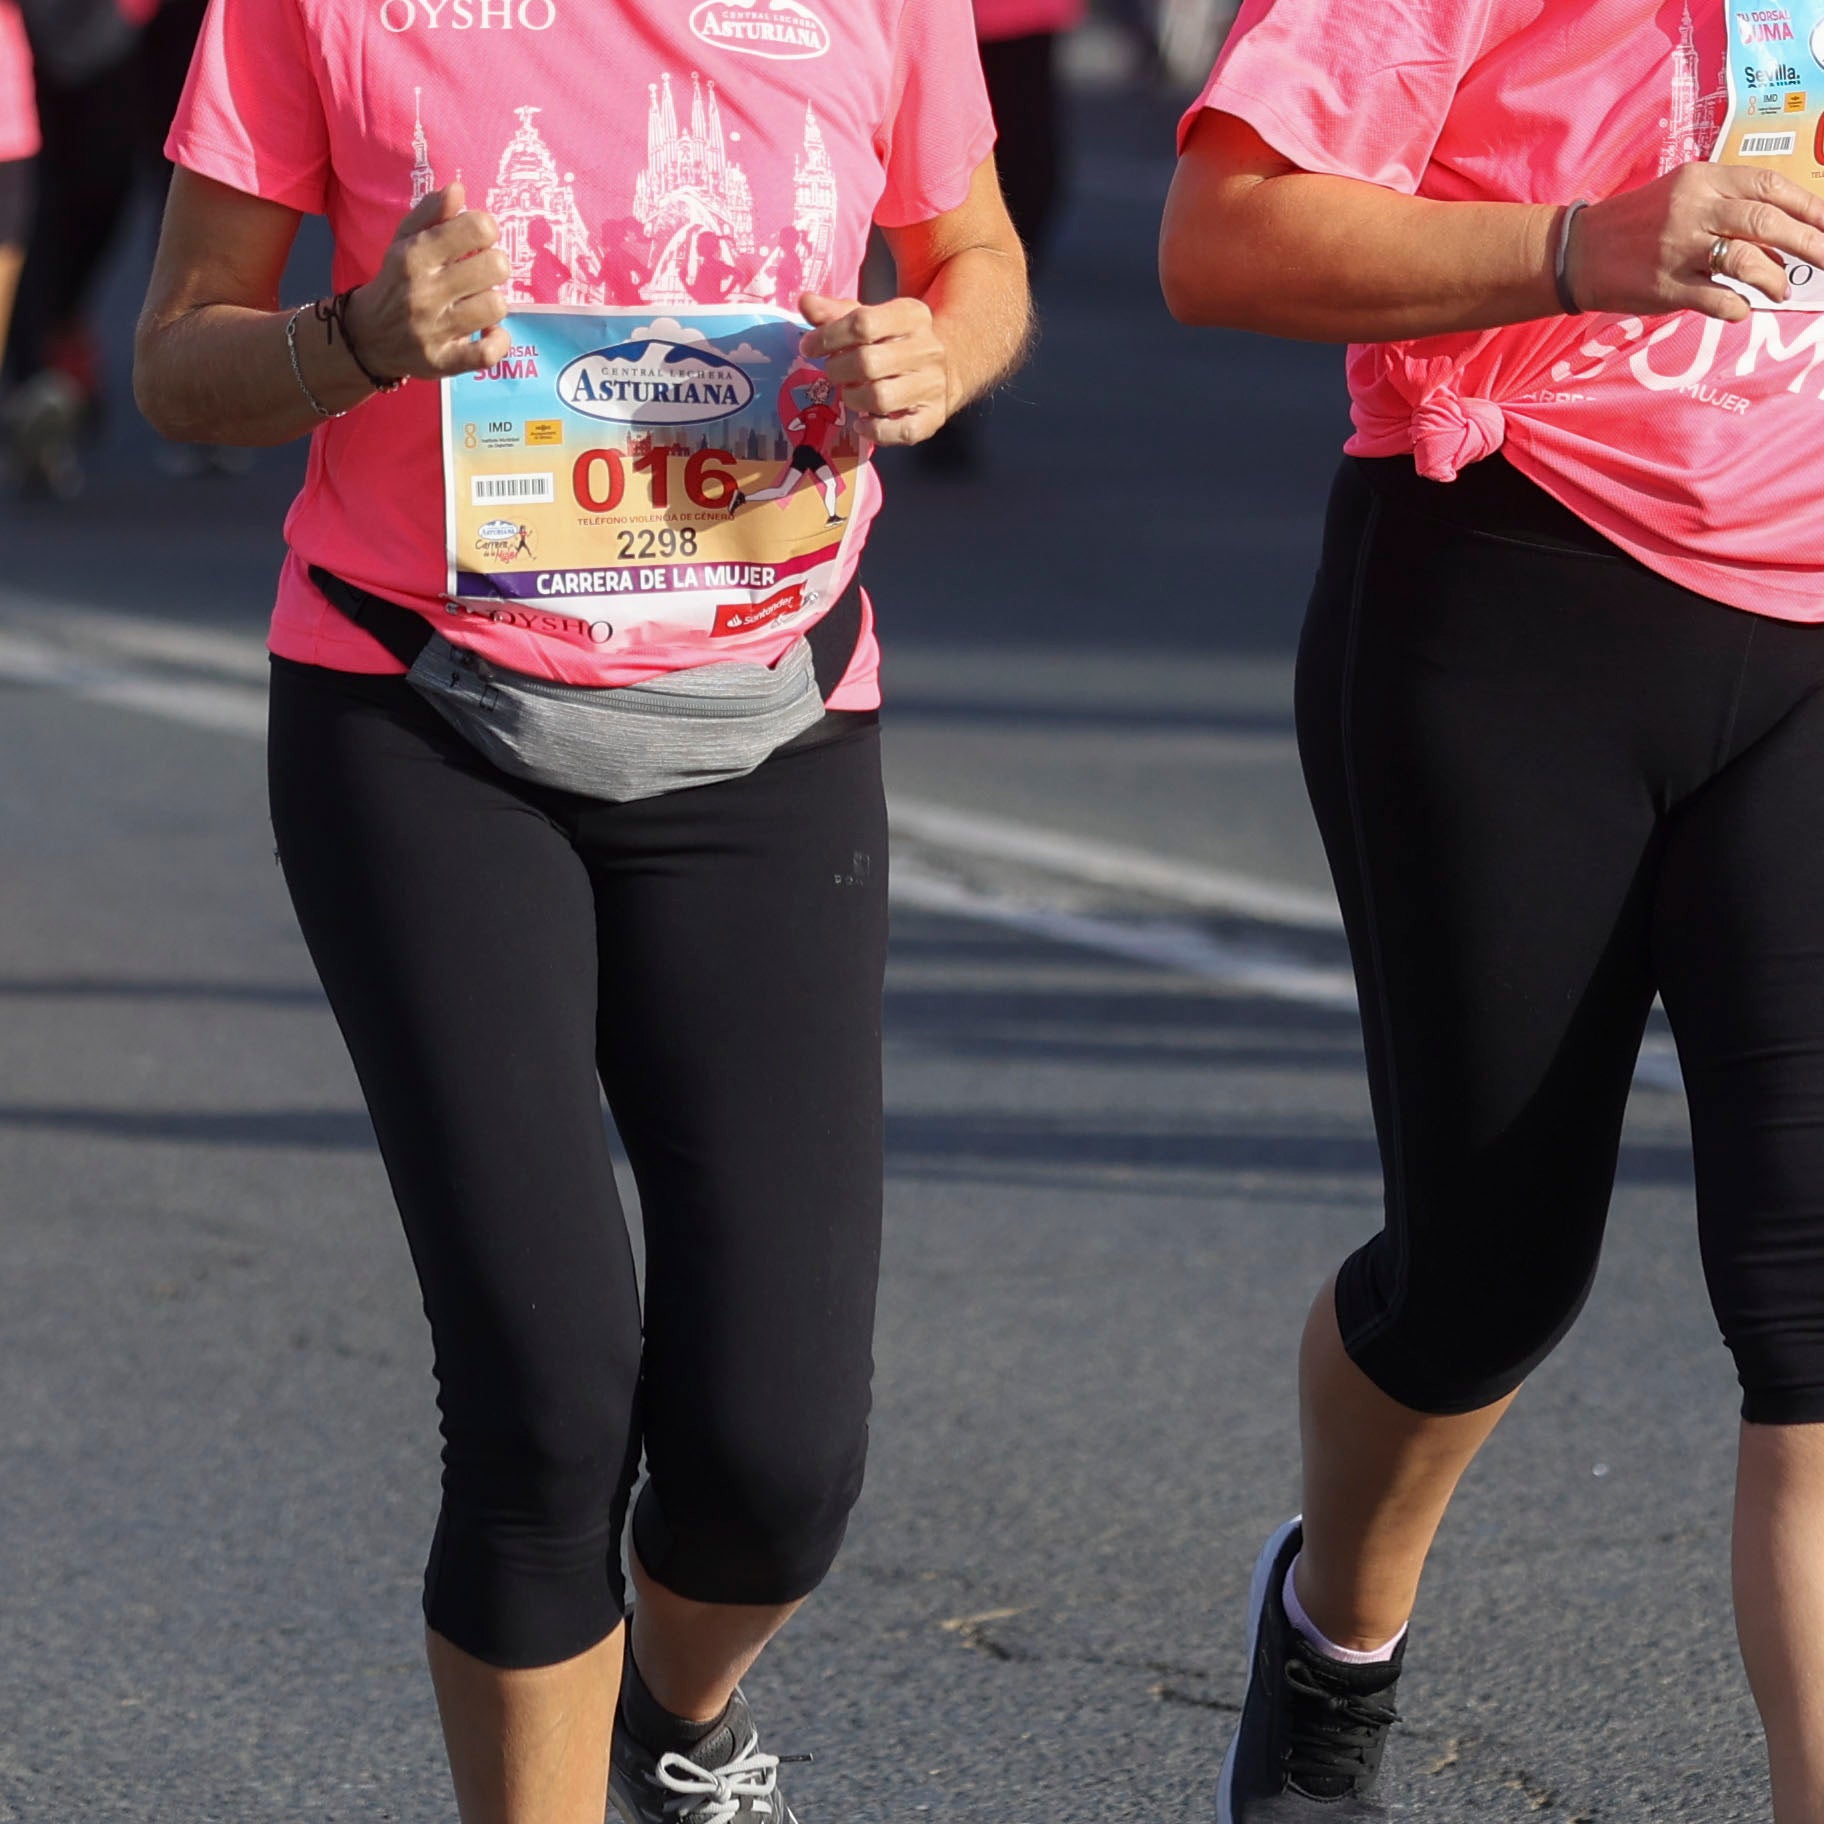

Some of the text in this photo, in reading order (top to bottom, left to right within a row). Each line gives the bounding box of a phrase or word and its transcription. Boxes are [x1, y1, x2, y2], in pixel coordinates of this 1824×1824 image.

[701, 11, 822, 49] ASTURIANA
[507, 344, 539, 357] RSAL
[571, 368, 740, 405] ASTURIANA
[601, 366, 733, 380] CENTRAL LECHERA
[489, 421, 513, 433] IMD
[572, 446, 739, 513] 016
[577, 516, 627, 526] TELÉFONO
[679, 513, 692, 521] DE
[694, 511, 735, 521] GÉNERO
[617, 527, 698, 560] 2298
[537, 565, 776, 595] CARRERA DE LA MUJER
[742, 596, 794, 625] Santander
